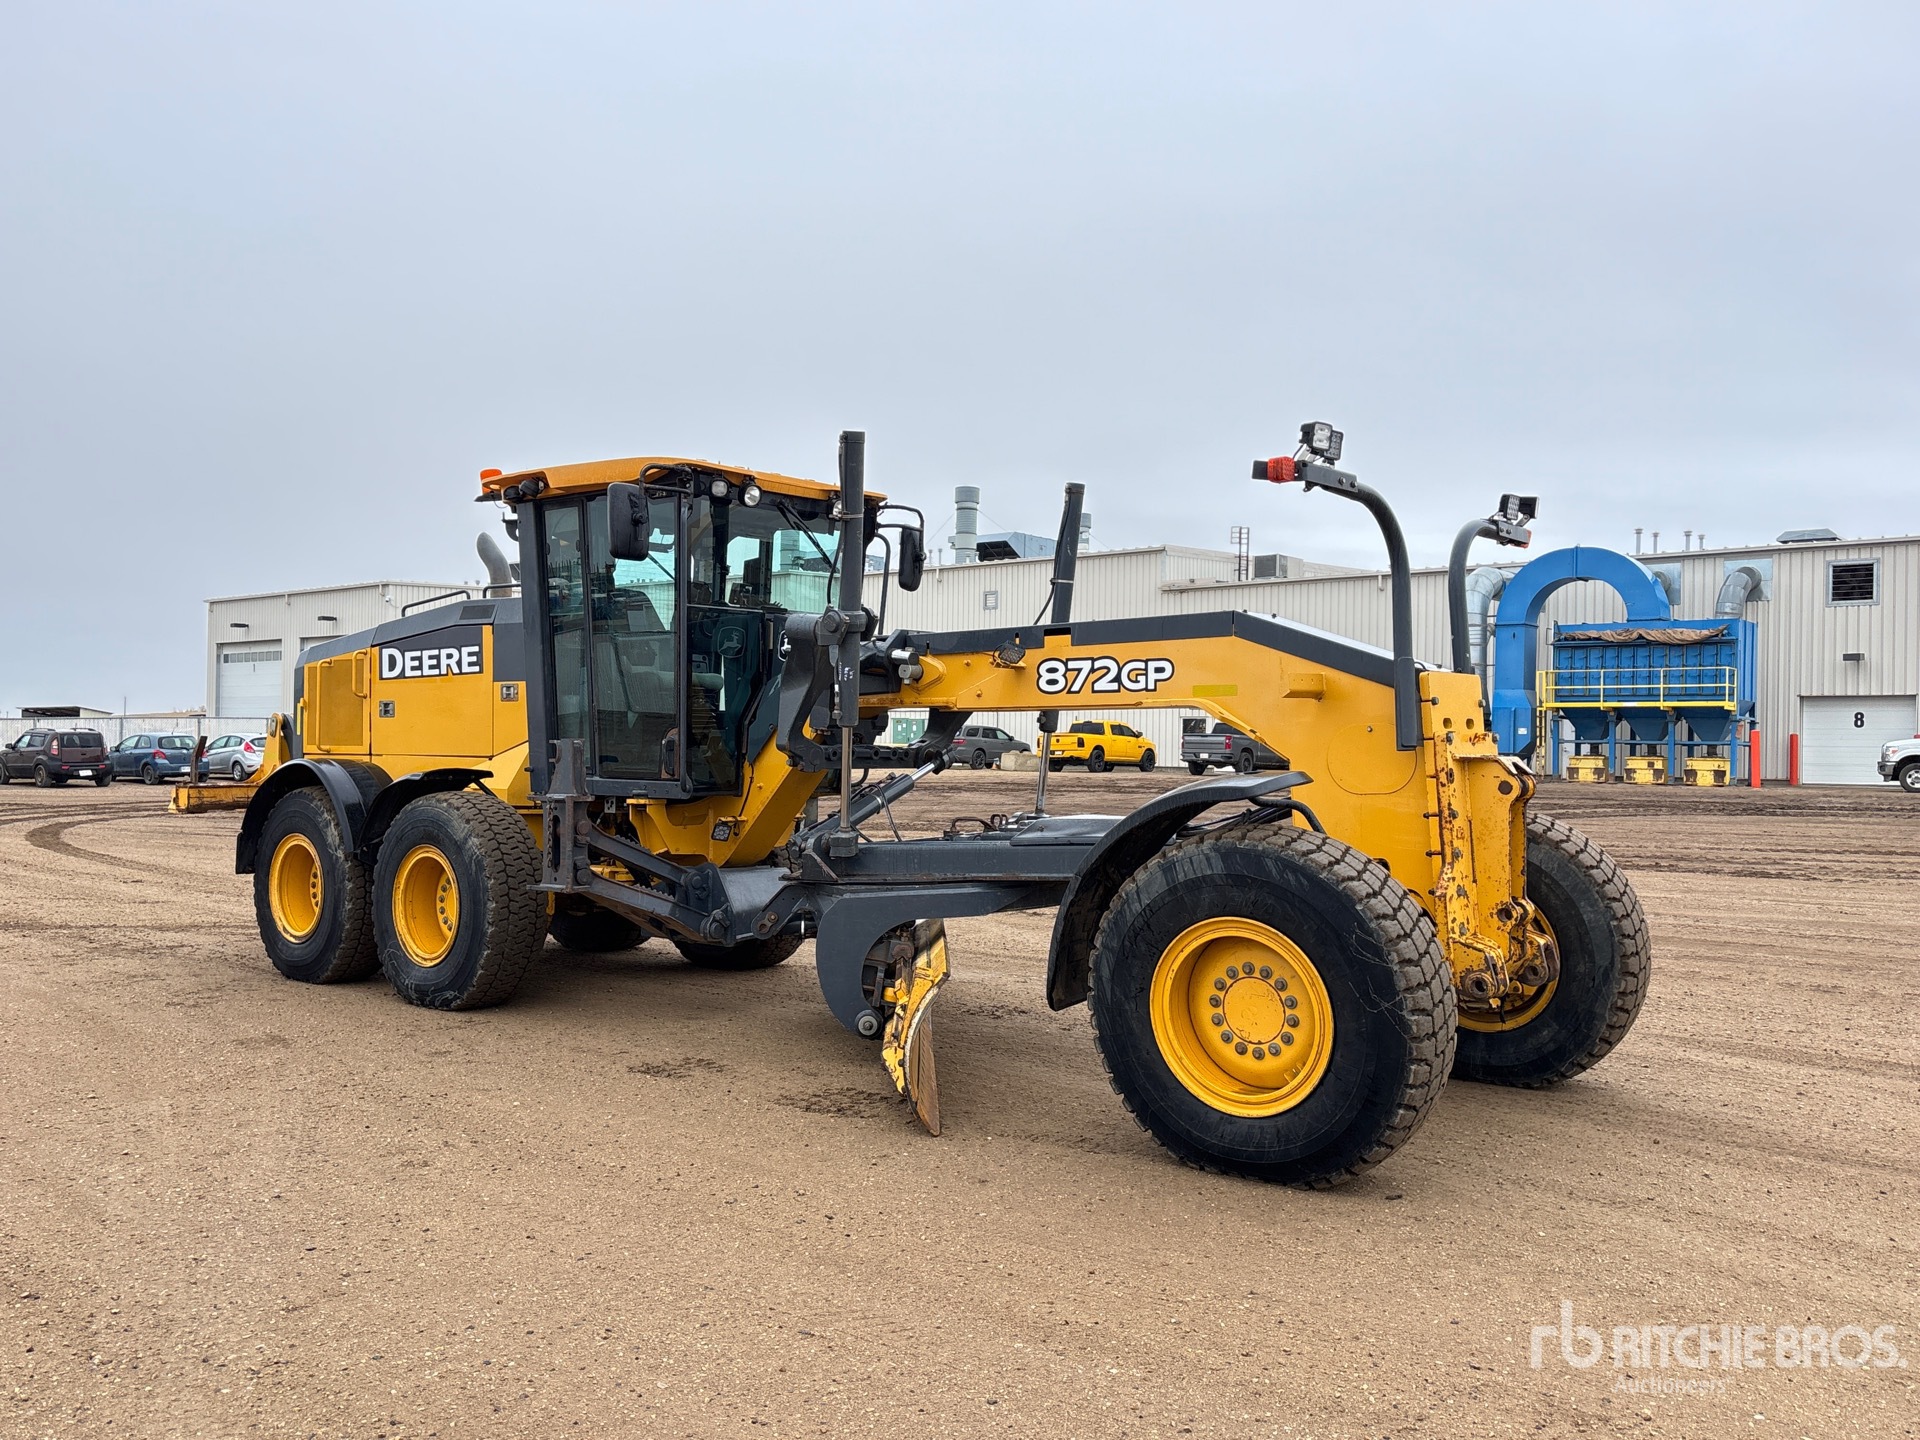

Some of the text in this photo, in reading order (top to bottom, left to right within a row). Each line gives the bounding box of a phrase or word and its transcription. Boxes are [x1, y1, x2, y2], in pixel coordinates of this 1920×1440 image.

[382, 646, 480, 678] DEERE
[1037, 656, 1174, 694] 872GP
[1853, 711, 1865, 729] 8
